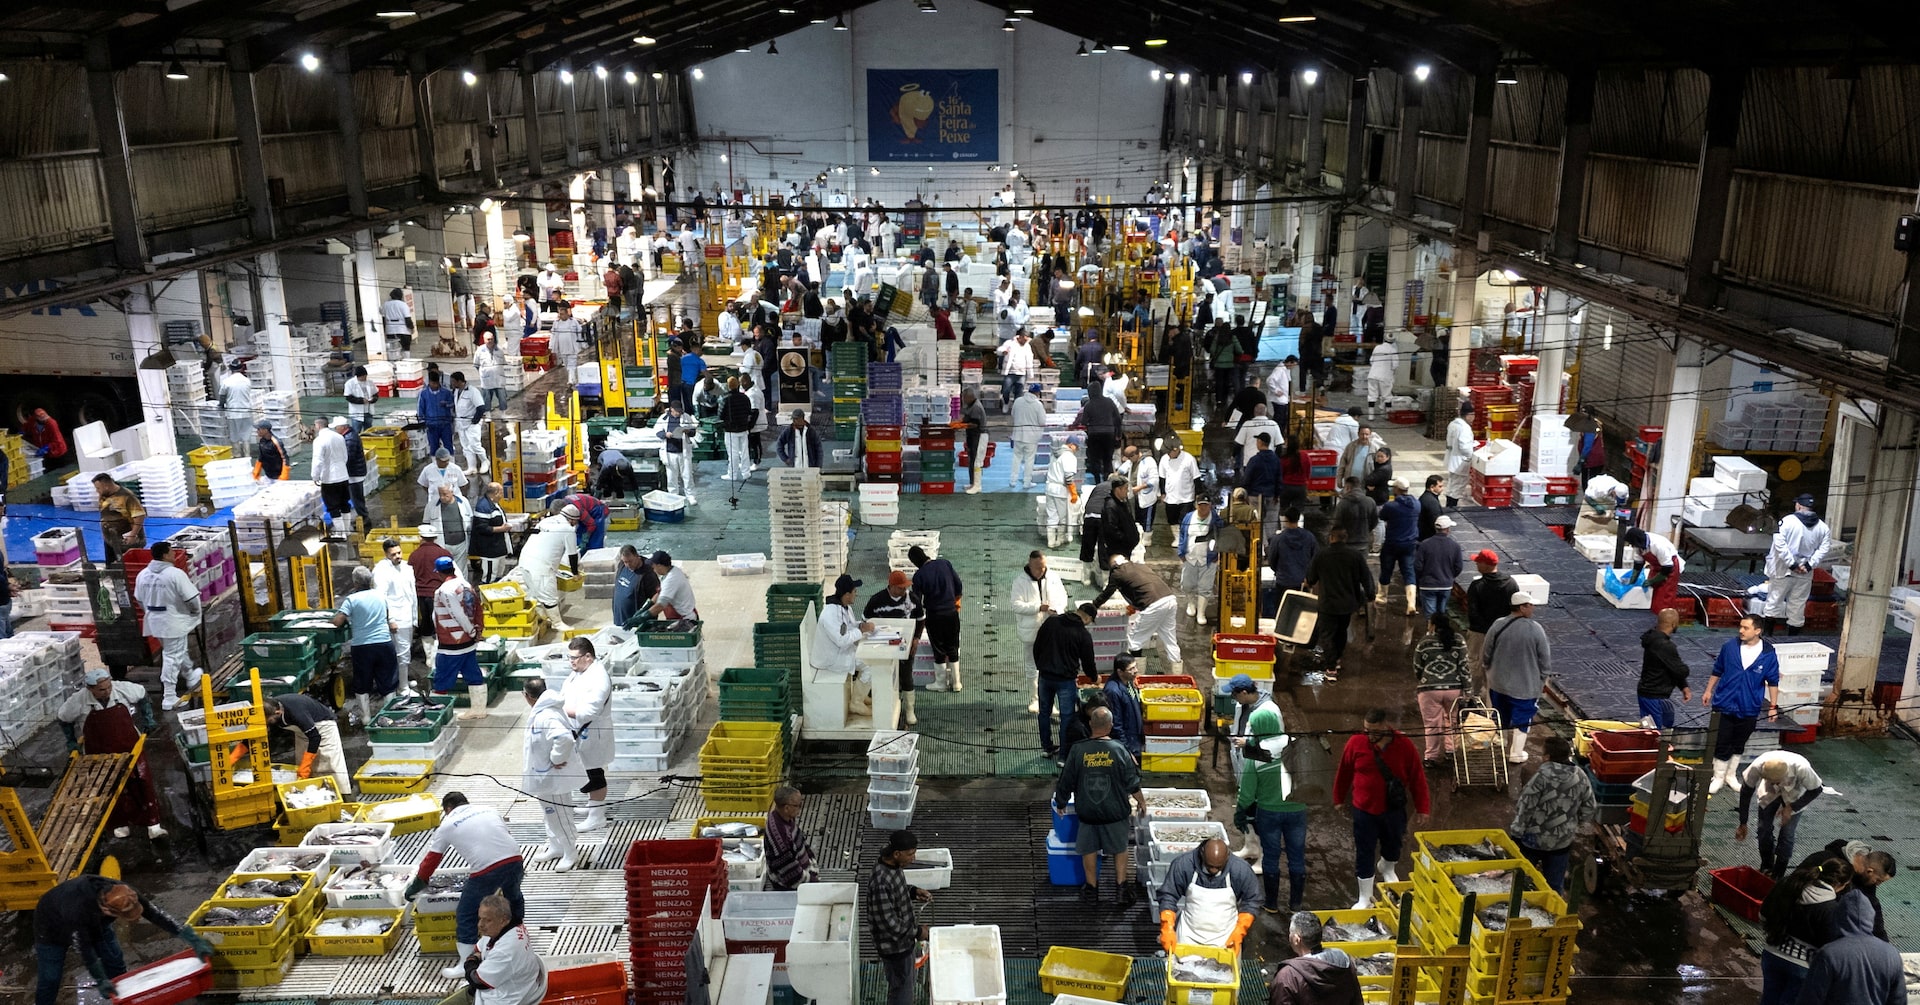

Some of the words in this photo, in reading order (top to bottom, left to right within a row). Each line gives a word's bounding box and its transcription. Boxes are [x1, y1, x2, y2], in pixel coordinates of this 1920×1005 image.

[939, 100, 972, 116] Santa
[939, 115, 968, 129] Feira
[939, 130, 970, 143] Peixe
[109, 351, 127, 360] Tel.
[217, 709, 243, 719] NINO
[249, 708, 256, 716] E
[221, 717, 249, 727] JACK
[251, 740, 260, 782] PEIXE
[261, 742, 269, 768] BOM
[216, 744, 227, 784] GRUPO
[412, 815, 424, 823] BOM
[1056, 980, 1075, 988] GRUPO
[1076, 982, 1091, 990] PEIXE
